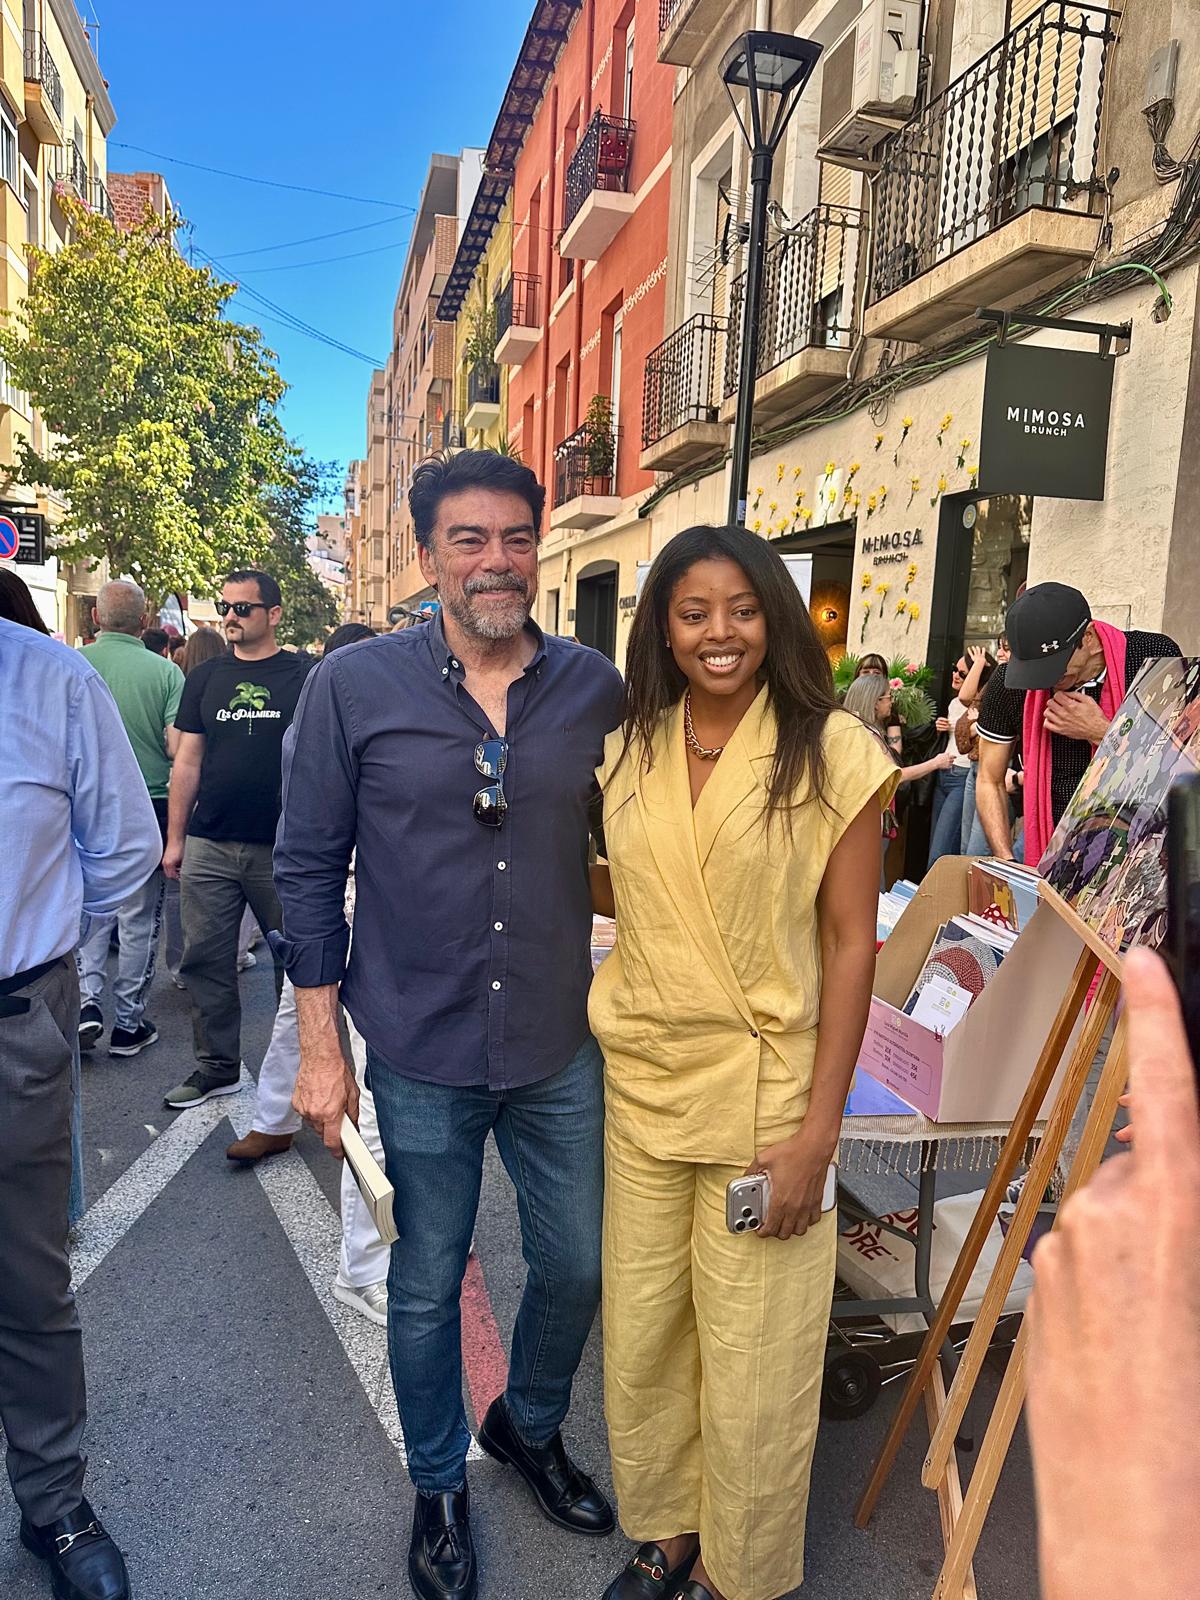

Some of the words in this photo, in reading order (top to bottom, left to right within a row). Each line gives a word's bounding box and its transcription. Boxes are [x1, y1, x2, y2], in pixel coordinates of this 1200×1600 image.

[1006, 406, 1085, 429] MIMOSA
[1024, 425, 1067, 437] BRUNCH
[861, 528, 924, 555] MIMOSA
